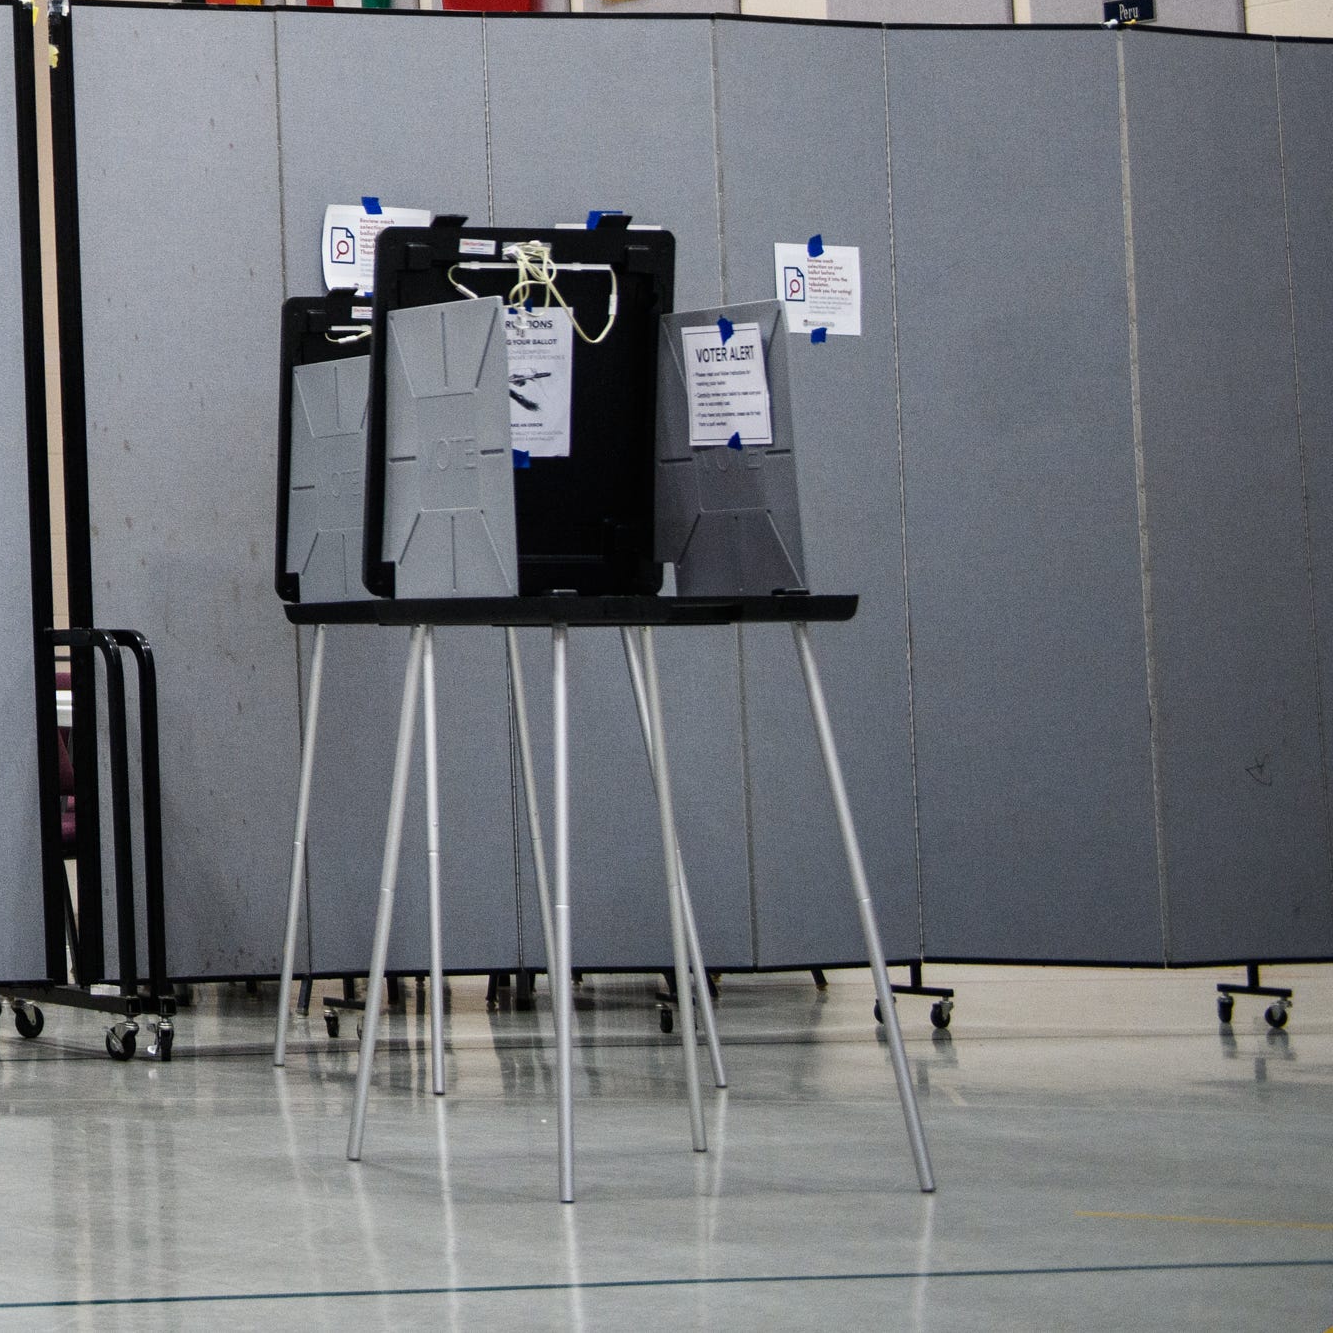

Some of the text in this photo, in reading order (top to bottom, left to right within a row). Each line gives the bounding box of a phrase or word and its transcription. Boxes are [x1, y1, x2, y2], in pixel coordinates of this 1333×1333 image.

[1119, 3, 1139, 21] Peru
[696, 345, 755, 363] VOTER ALERT
